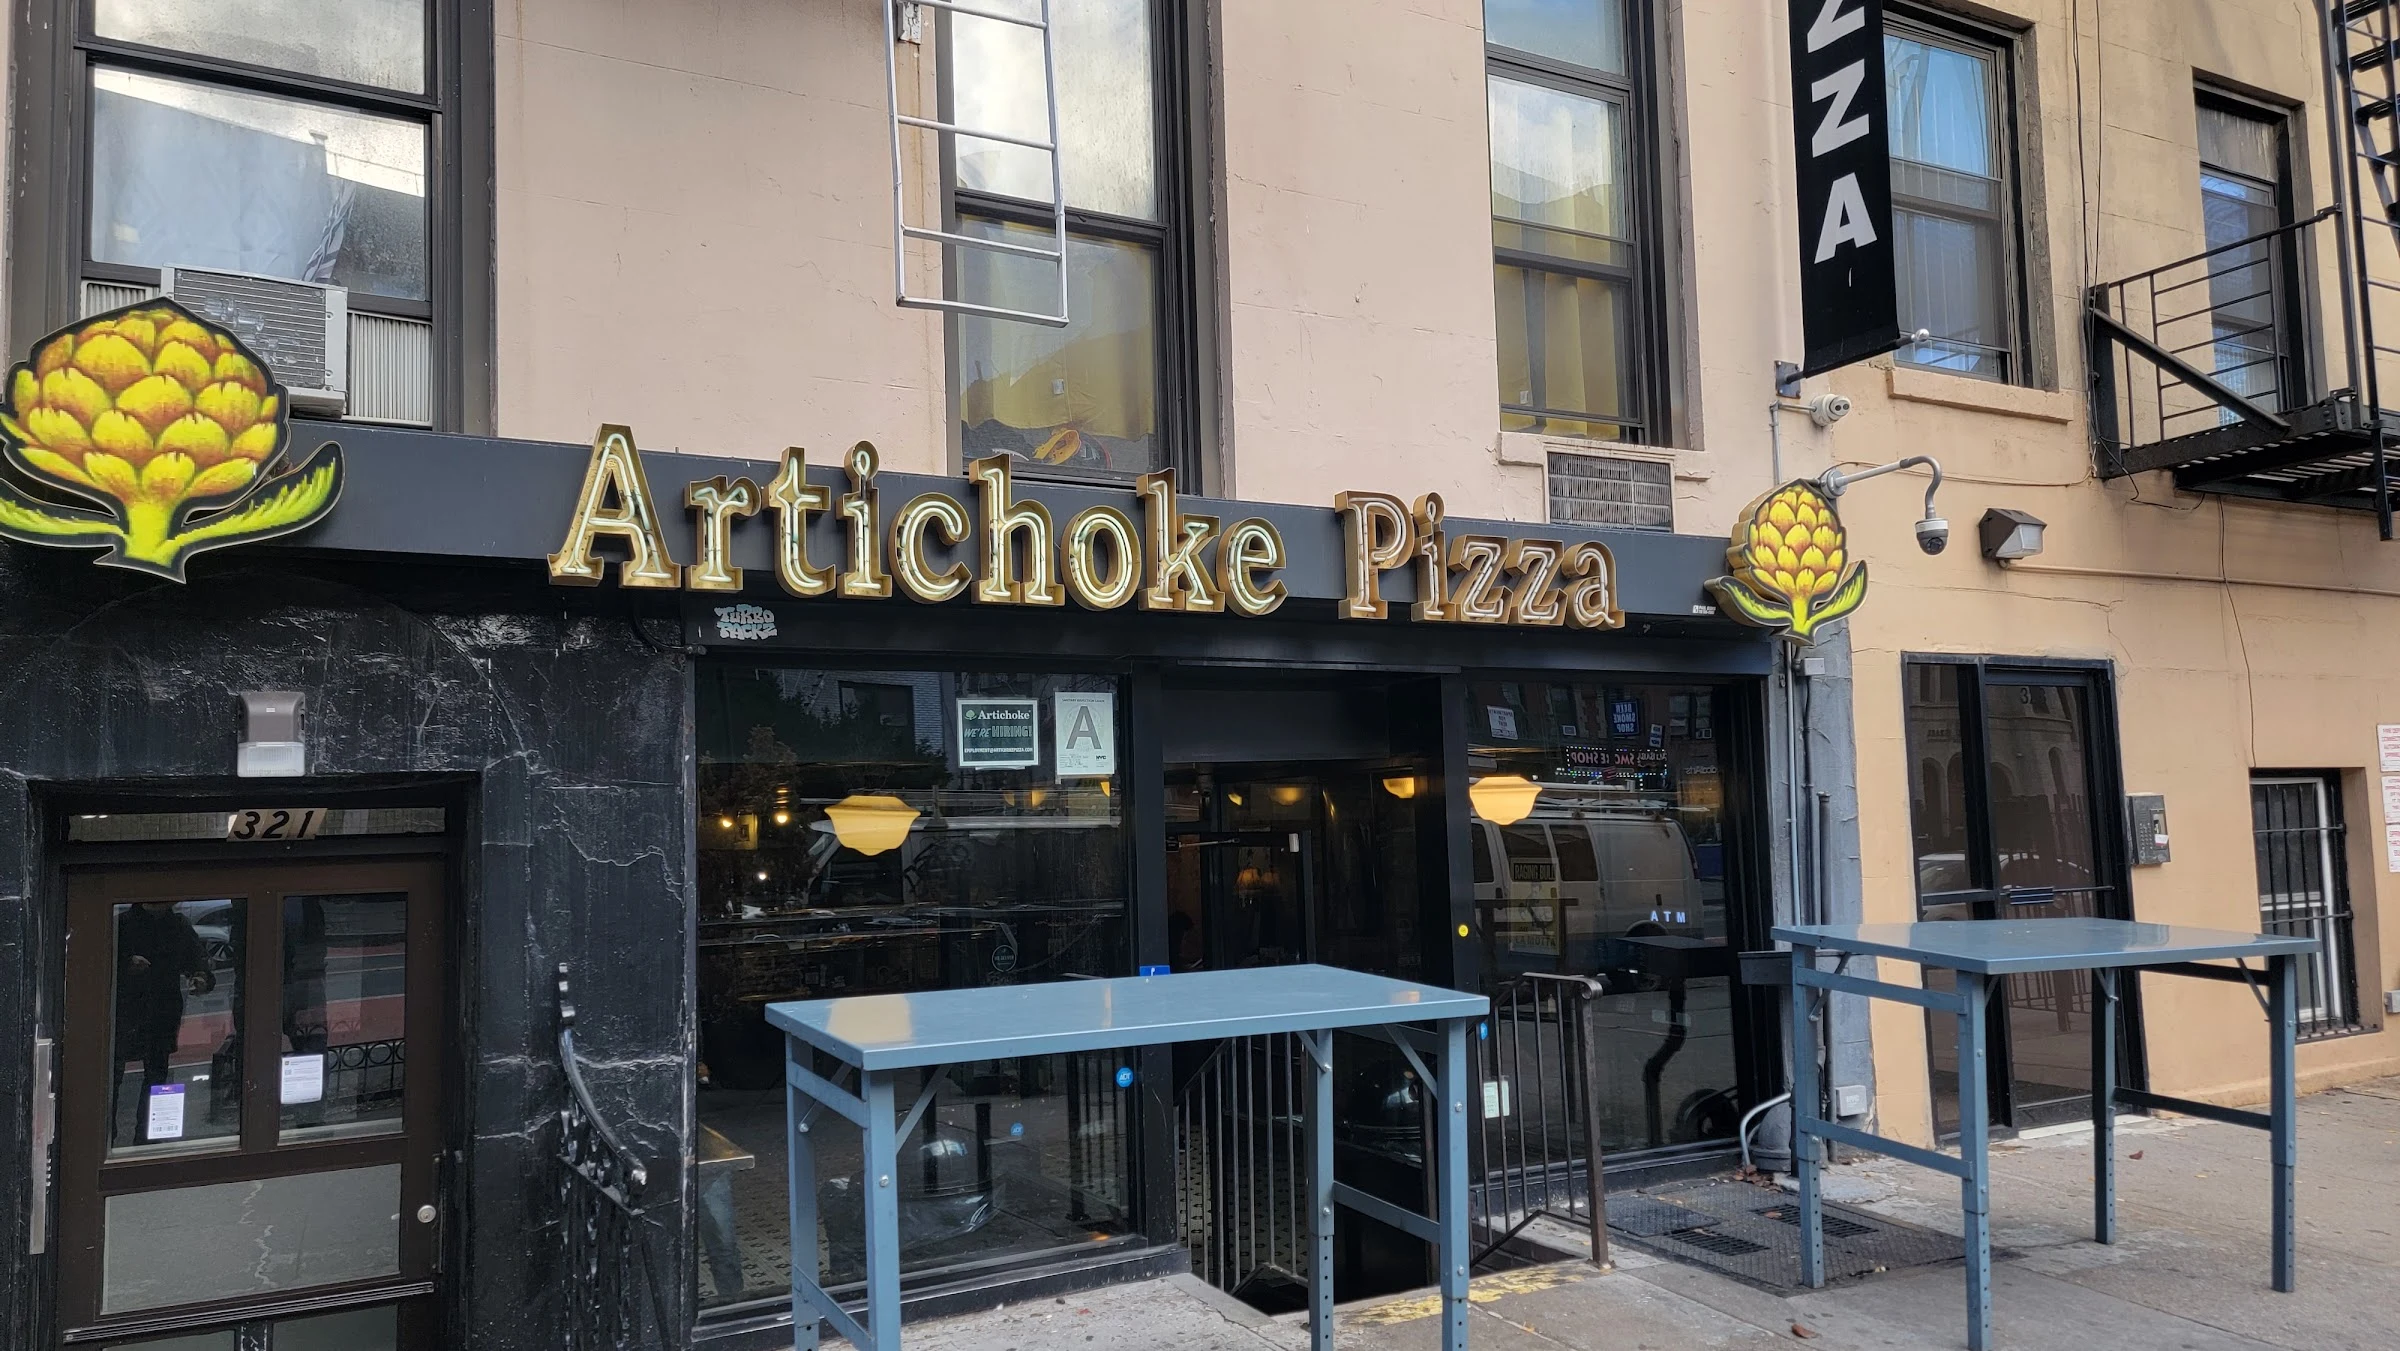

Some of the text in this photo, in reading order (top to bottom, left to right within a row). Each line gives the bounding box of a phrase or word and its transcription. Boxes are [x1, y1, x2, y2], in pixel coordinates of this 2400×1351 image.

[547, 423, 1625, 628] Artichoke Pizza
[978, 709, 1030, 720] Artichoke
[964, 725, 1032, 738] WE'RE HIRING!
[1066, 706, 1102, 749] A
[233, 811, 315, 839] 321
[1515, 864, 1538, 879] RAGING
[1650, 910, 1686, 923] ATM
[1119, 1073, 1131, 1081] ADT
